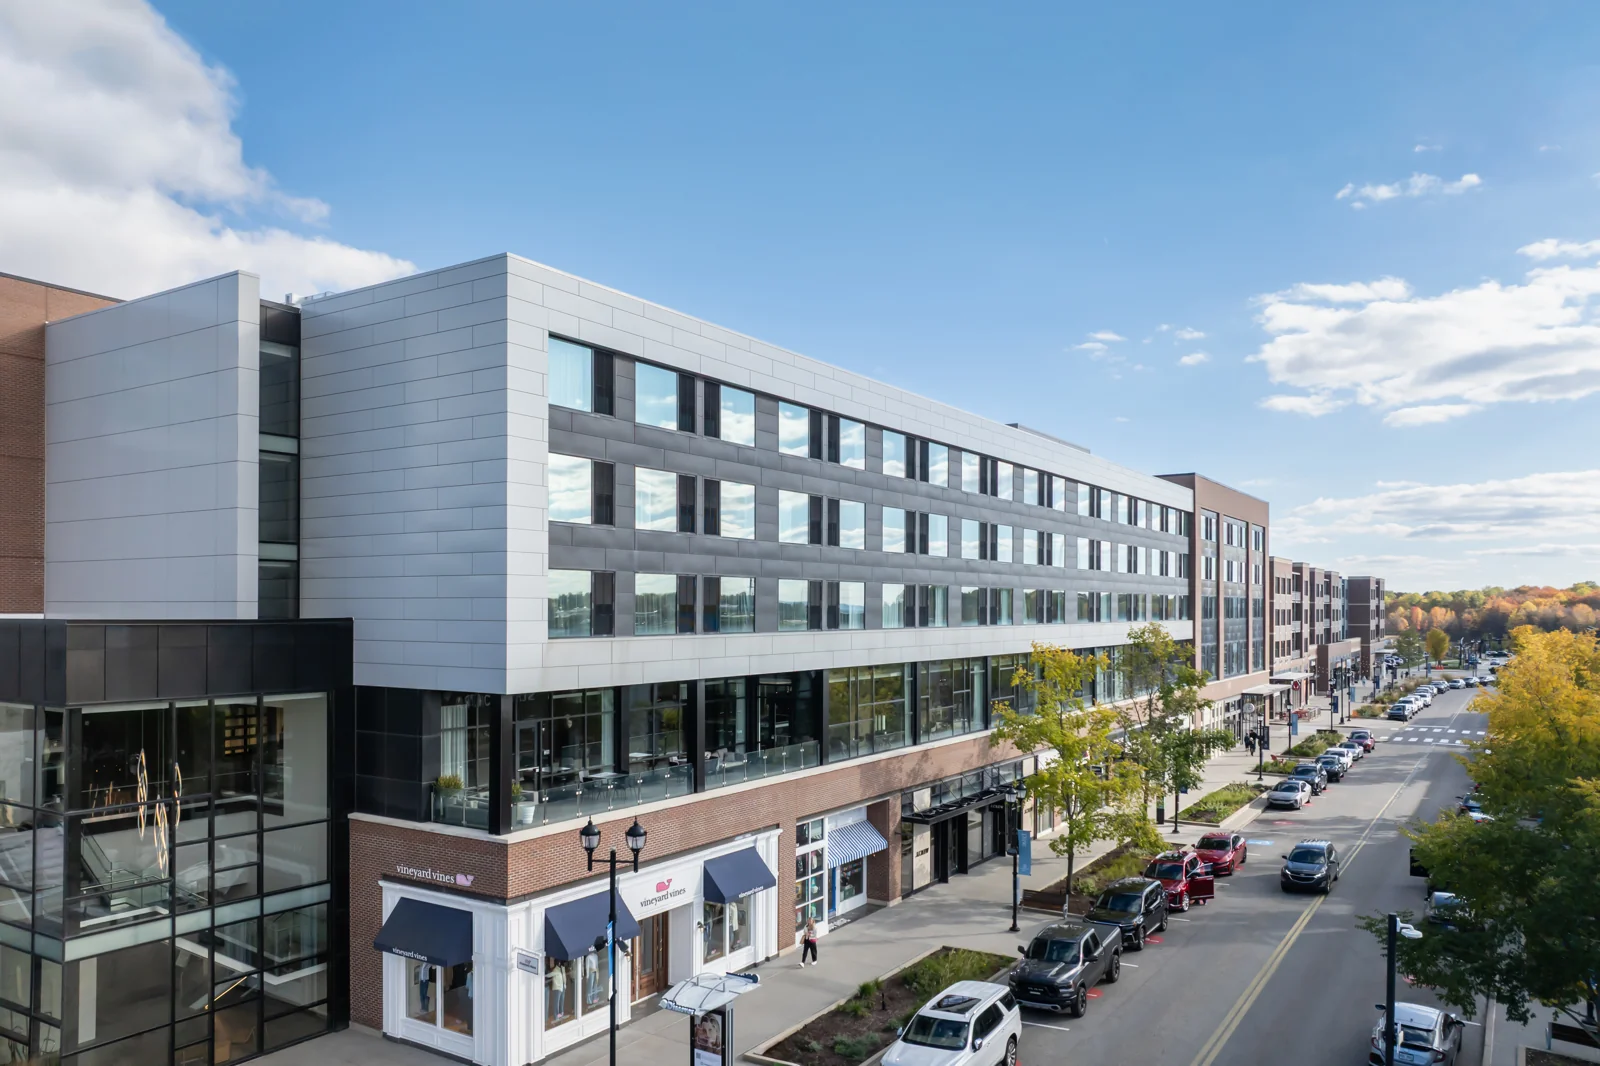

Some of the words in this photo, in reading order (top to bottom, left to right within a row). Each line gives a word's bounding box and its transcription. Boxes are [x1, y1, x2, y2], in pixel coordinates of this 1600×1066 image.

[396, 864, 431, 879] vineyard
[432, 871, 455, 883] vines
[640, 891, 669, 907] vineyard
[669, 888, 686, 898] vines
[392, 947, 414, 958] vineyard
[414, 952, 428, 961] vines
